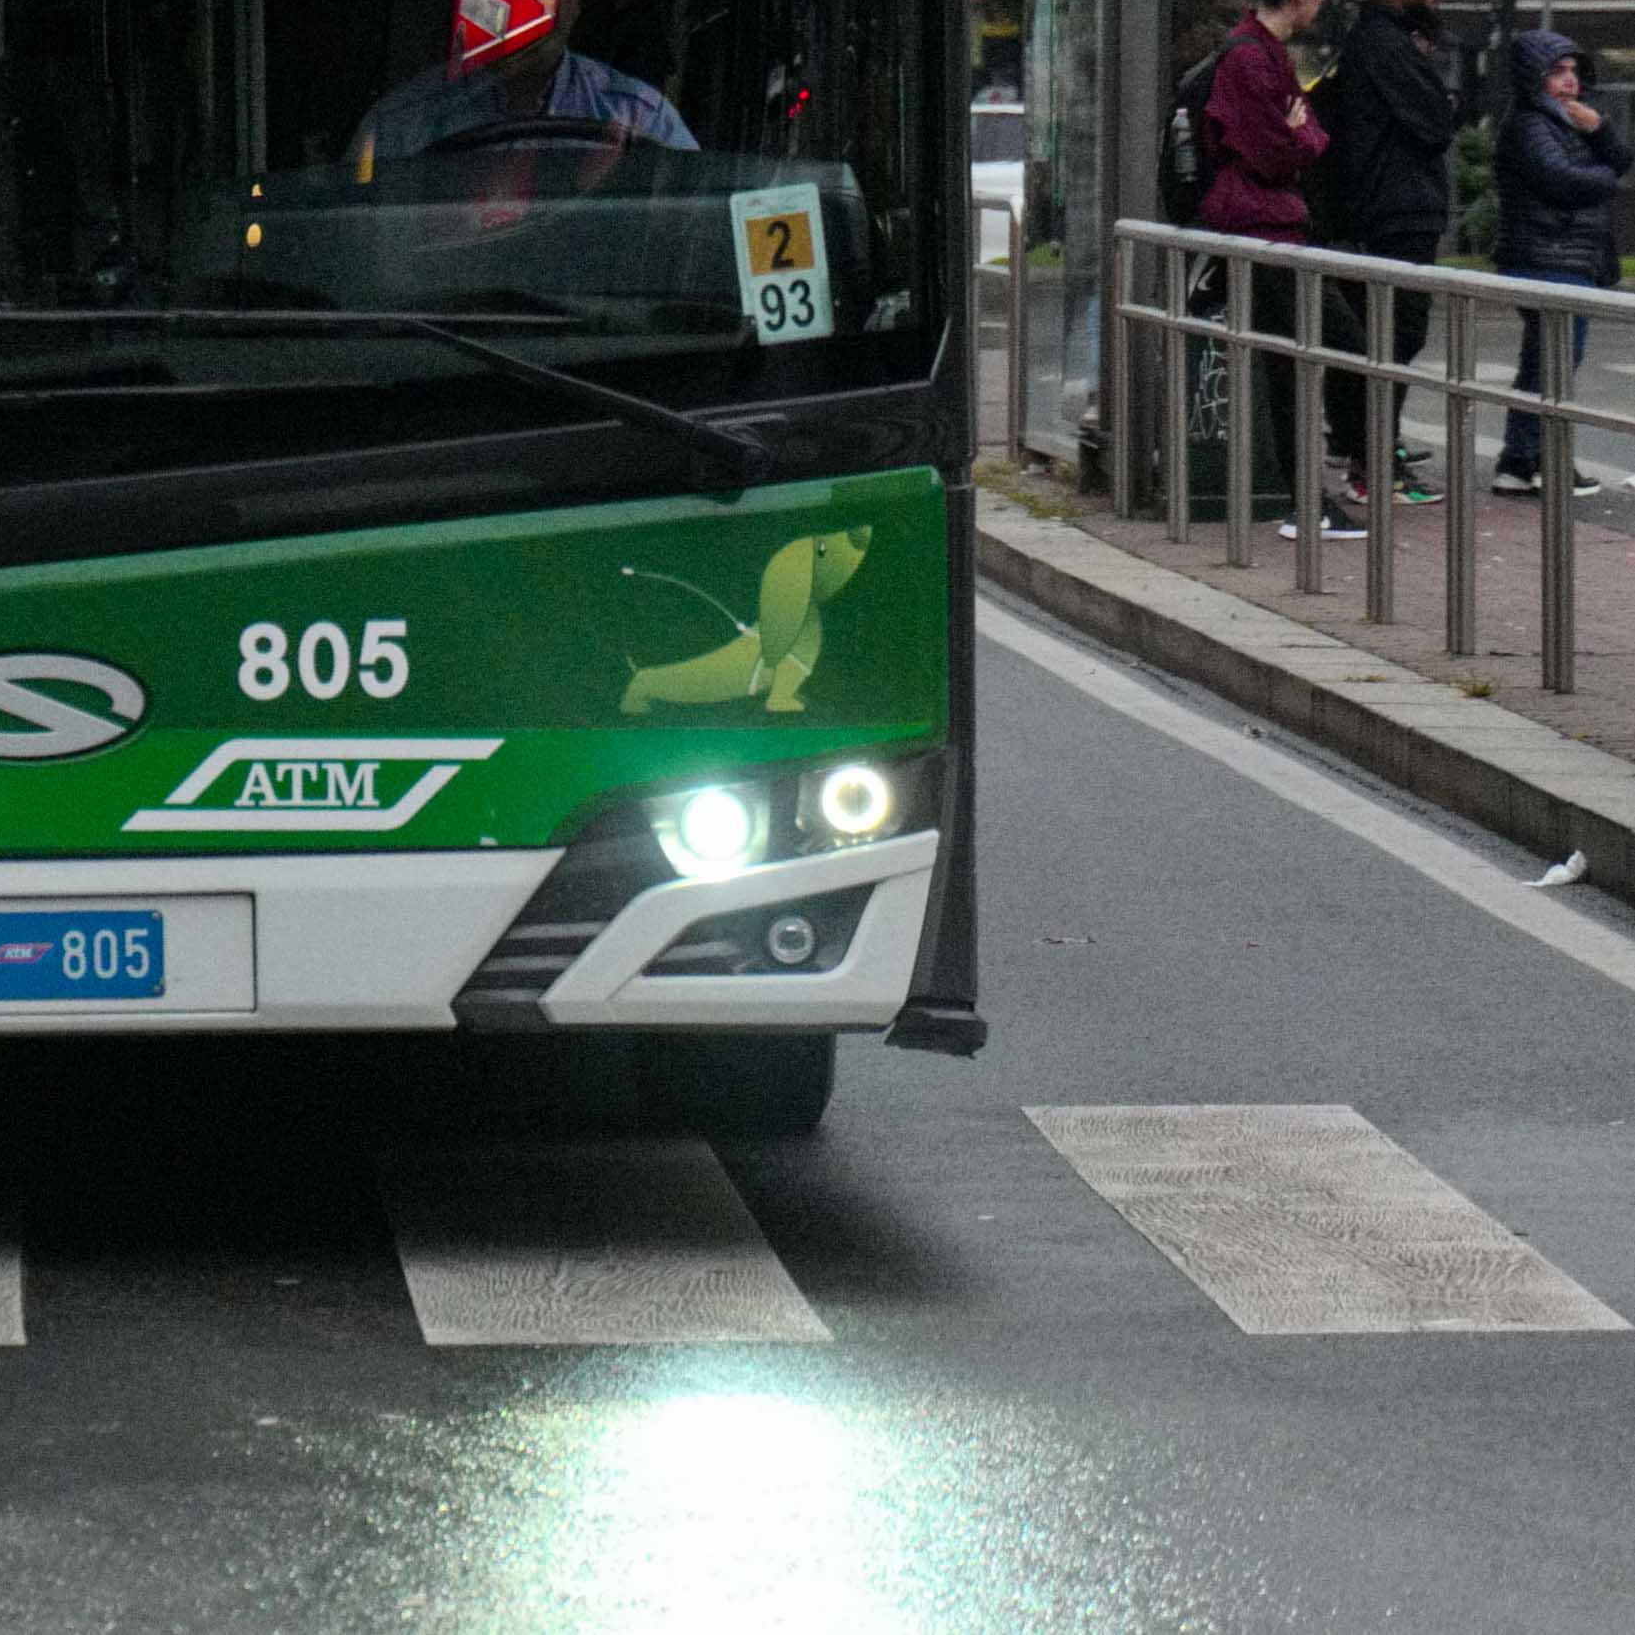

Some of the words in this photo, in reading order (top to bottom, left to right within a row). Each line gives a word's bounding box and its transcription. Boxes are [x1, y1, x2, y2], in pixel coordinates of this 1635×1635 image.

[766, 220, 796, 270] 2
[760, 279, 815, 332] 93
[237, 620, 410, 701] 805
[235, 762, 381, 808] ATM
[62, 928, 150, 980] 805
